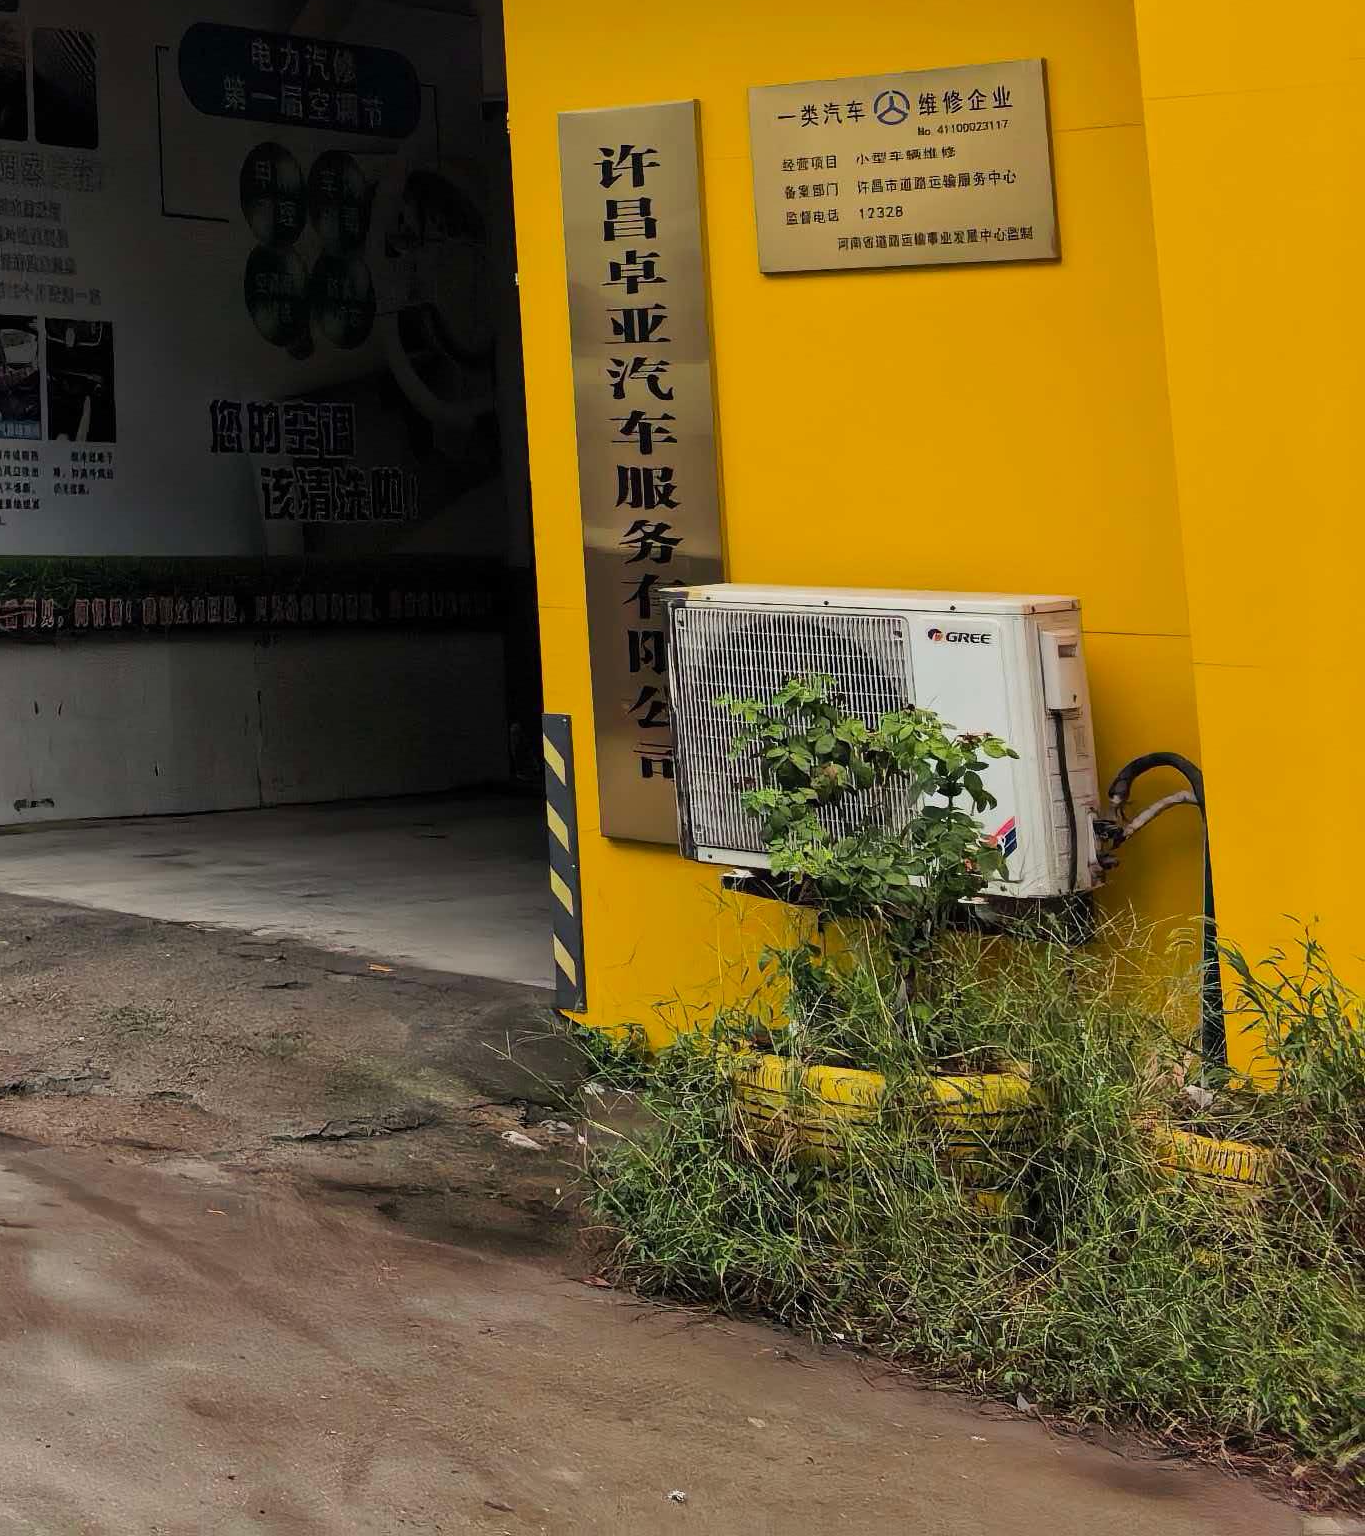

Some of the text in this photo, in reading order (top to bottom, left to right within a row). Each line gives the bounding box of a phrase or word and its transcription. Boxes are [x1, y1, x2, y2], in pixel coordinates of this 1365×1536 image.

[777, 85, 1014, 128] 一类汽车 维修企业
[781, 144, 957, 173] 经营项目 小型车辆维修
[784, 169, 1017, 200] 备案部门 许昌市道路运输服务中心
[785, 206, 904, 226] 监督电话 12328
[945, 631, 992, 645] GREE
